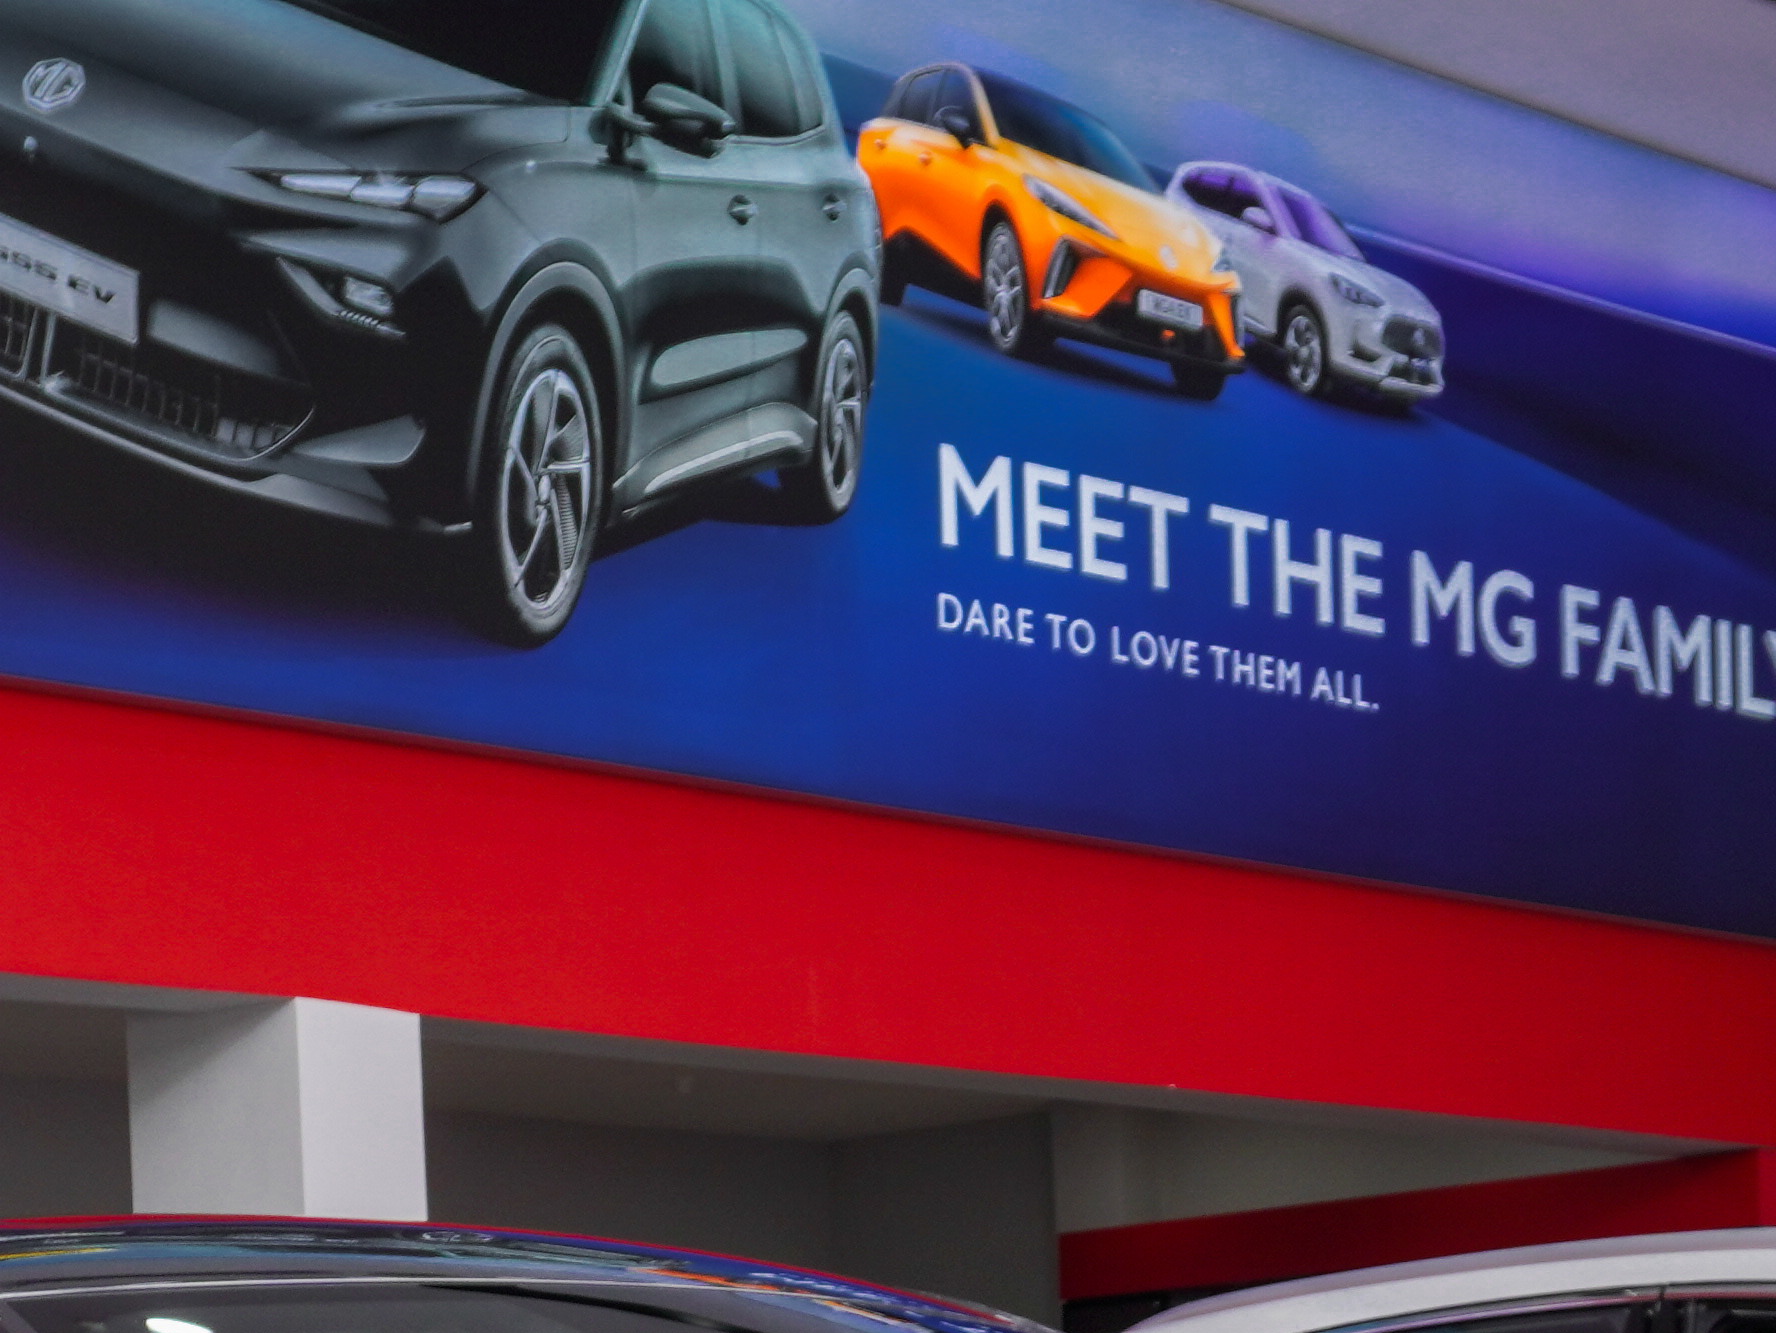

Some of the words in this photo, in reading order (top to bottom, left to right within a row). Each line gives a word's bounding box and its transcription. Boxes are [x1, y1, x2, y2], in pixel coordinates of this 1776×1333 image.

[68, 274, 117, 304] EV
[938, 442, 1190, 590] MEET
[1208, 503, 1386, 636] THE
[1410, 549, 1537, 668] MG
[937, 592, 1034, 645] DARE
[1045, 612, 1096, 656] TO
[1111, 625, 1200, 677] LOVE
[1208, 644, 1302, 697] THEM
[1310, 667, 1381, 711] ALL.
